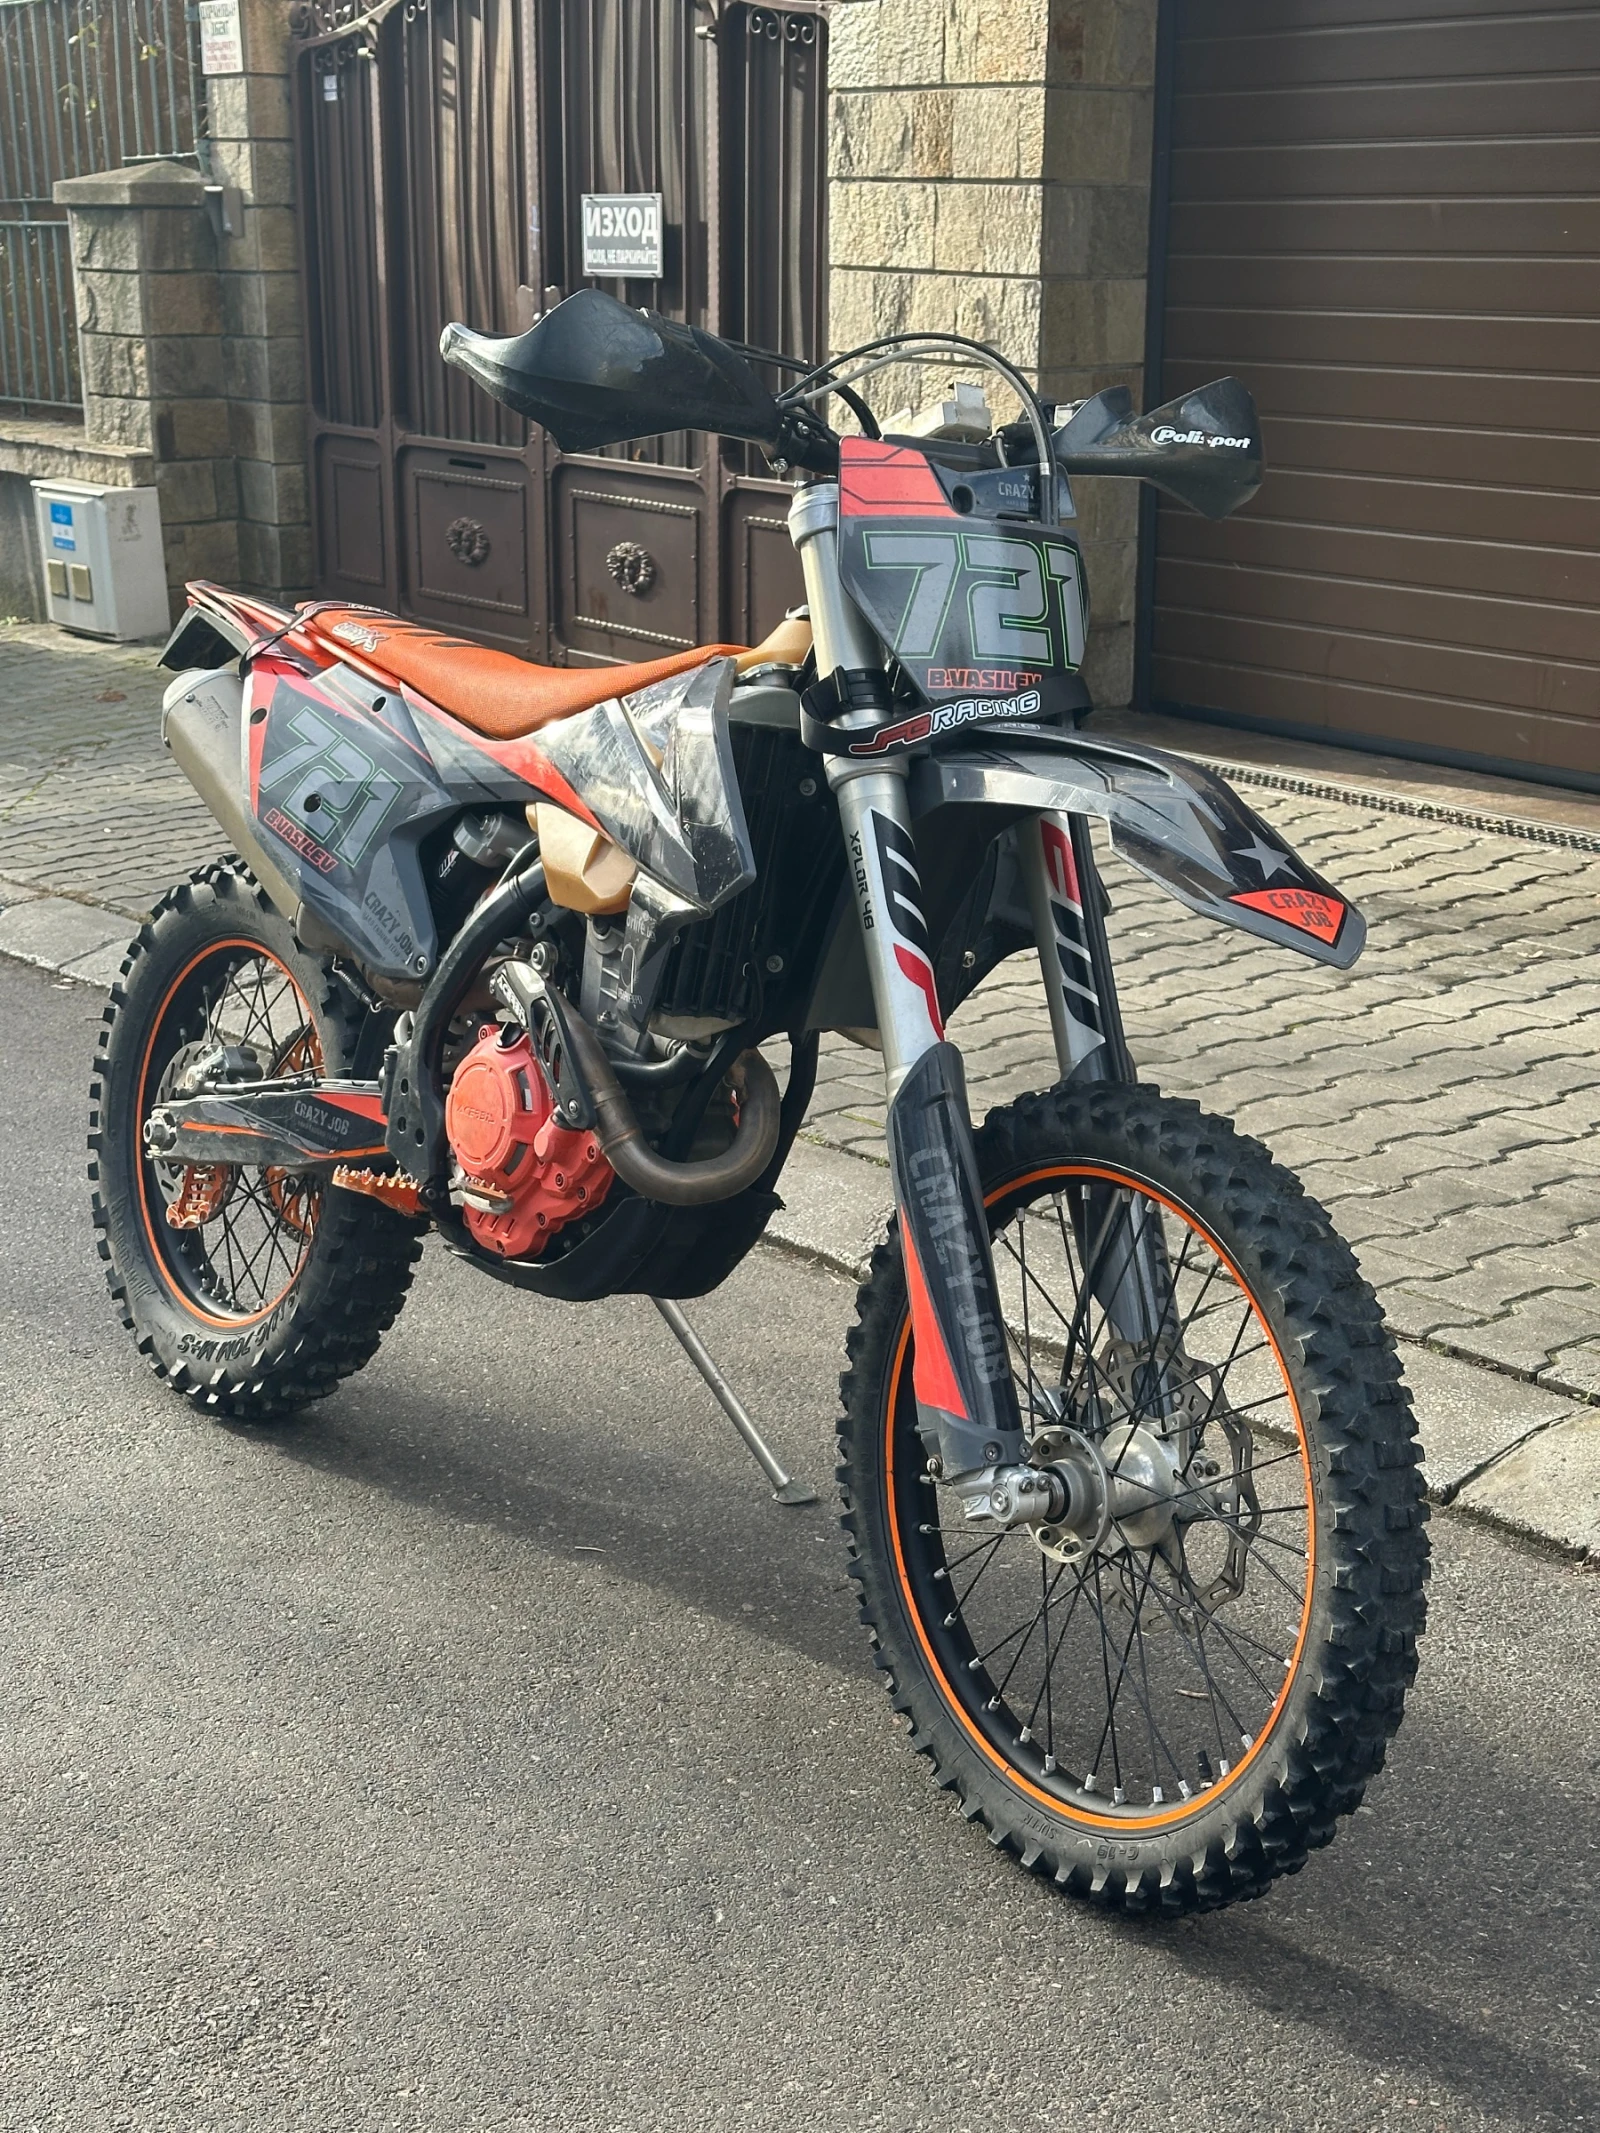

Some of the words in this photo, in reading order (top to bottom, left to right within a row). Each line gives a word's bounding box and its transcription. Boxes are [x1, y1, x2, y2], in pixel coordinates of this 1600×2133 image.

[586, 206, 658, 244] ИЗХОД
[998, 481, 1035, 499] CRAZY
[862, 531, 1087, 672] 721
[930, 690, 1041, 735] RACING
[259, 706, 404, 868] 721
[263, 807, 339, 873] B.VASILEV
[849, 829, 869, 898] XPLOR
[861, 898, 875, 931] 48
[364, 891, 401, 934] CRAZY
[1267, 892, 1332, 913] CRAZY
[1300, 909, 1334, 928] JOB
[294, 1100, 329, 1126] CRAZY
[327, 1116, 350, 1136] JOB
[908, 1146, 988, 1289] CRAZY
[955, 1302, 1009, 1384] JOB
[1022, 1812, 1059, 1840] SUPER
[1096, 1844, 1140, 1861] C-19
